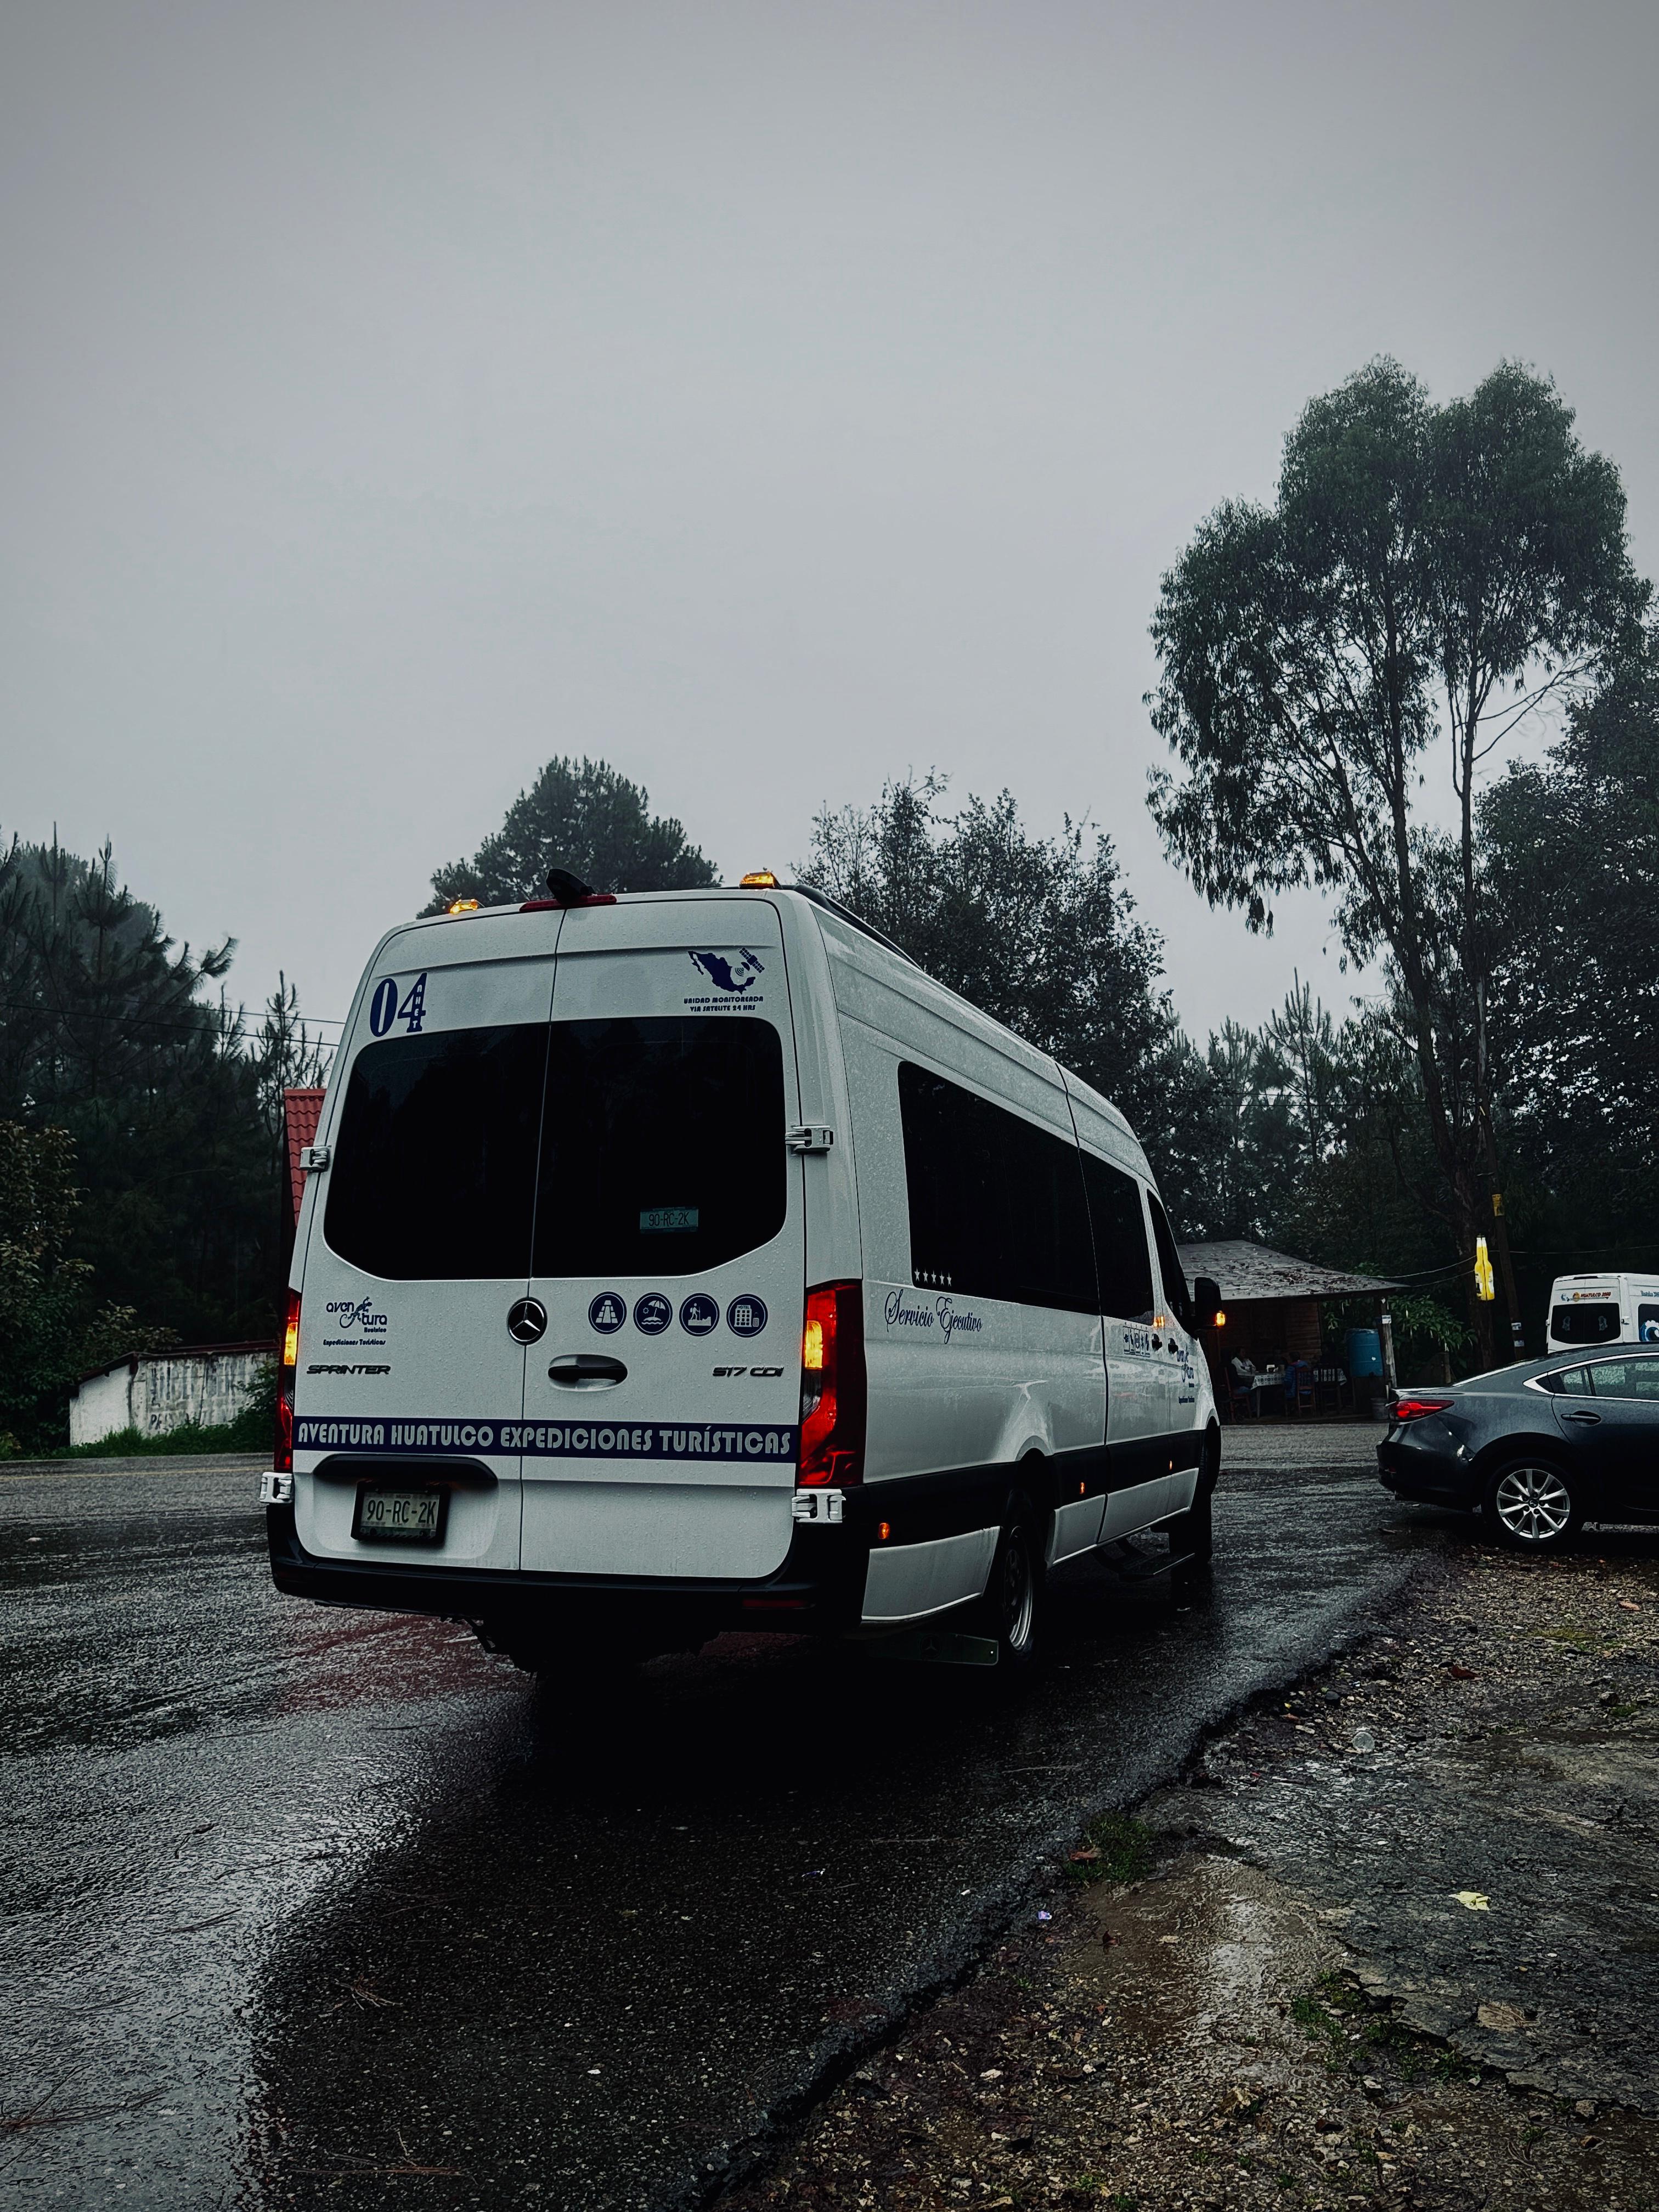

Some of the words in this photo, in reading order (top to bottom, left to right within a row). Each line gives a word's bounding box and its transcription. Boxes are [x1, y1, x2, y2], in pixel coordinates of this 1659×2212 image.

[370, 972, 427, 1037] 04
[648, 1211, 690, 1227] 90-RC-2K
[884, 1289, 934, 1333] Servicio
[936, 1296, 983, 1344] Ejecutivo
[307, 1365, 391, 1374] SPRINTER
[749, 1367, 785, 1377] CDI
[298, 1423, 385, 1444] AVENTURA
[391, 1425, 494, 1447] HUATULCO
[500, 1427, 652, 1451] EXPEDICIONES
[659, 1425, 791, 1455] TURÍSTICAS
[366, 1499, 437, 1525] 90-RC-2K
